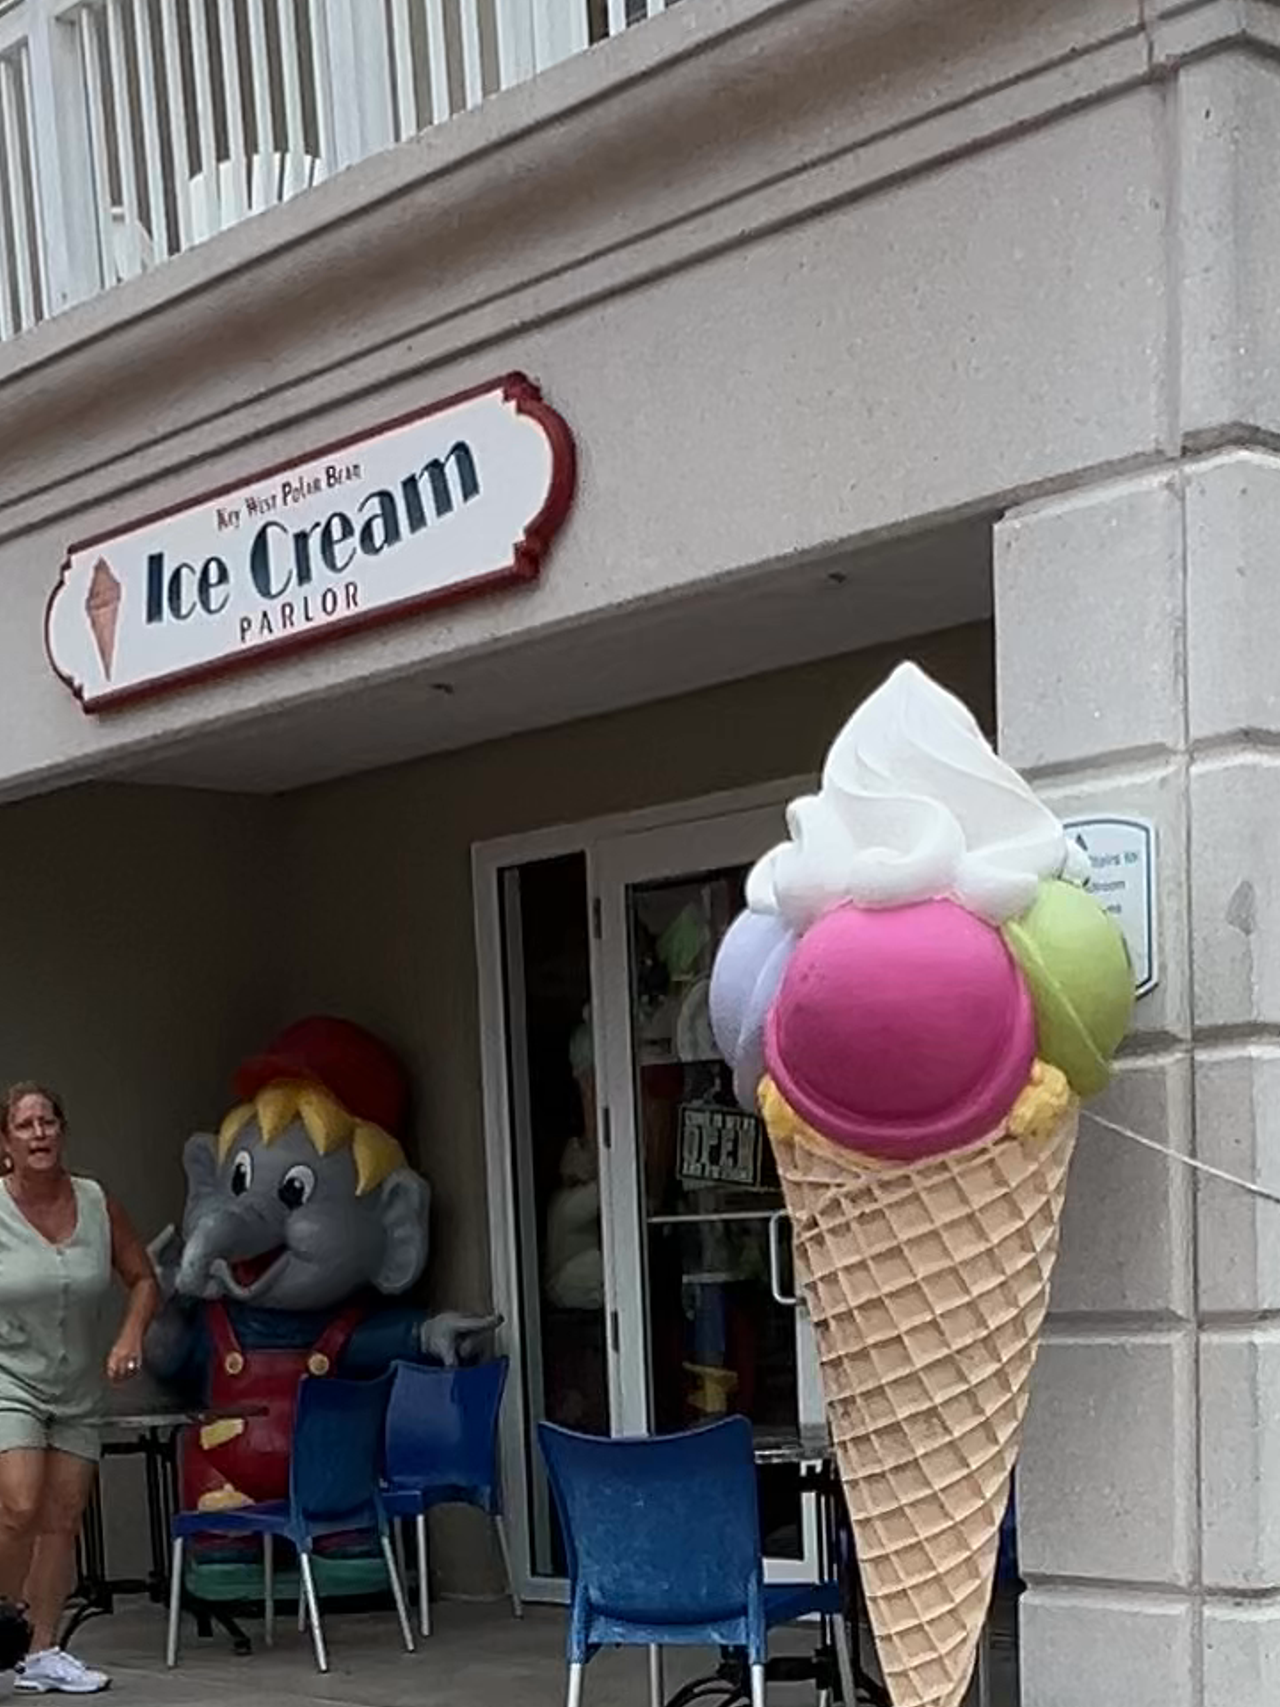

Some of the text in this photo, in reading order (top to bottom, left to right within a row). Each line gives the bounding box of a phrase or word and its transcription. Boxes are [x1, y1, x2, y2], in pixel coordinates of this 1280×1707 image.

[145, 440, 480, 624] Ice Cream
[239, 581, 360, 643] PARLOR
[683, 1127, 754, 1167] OPEN
